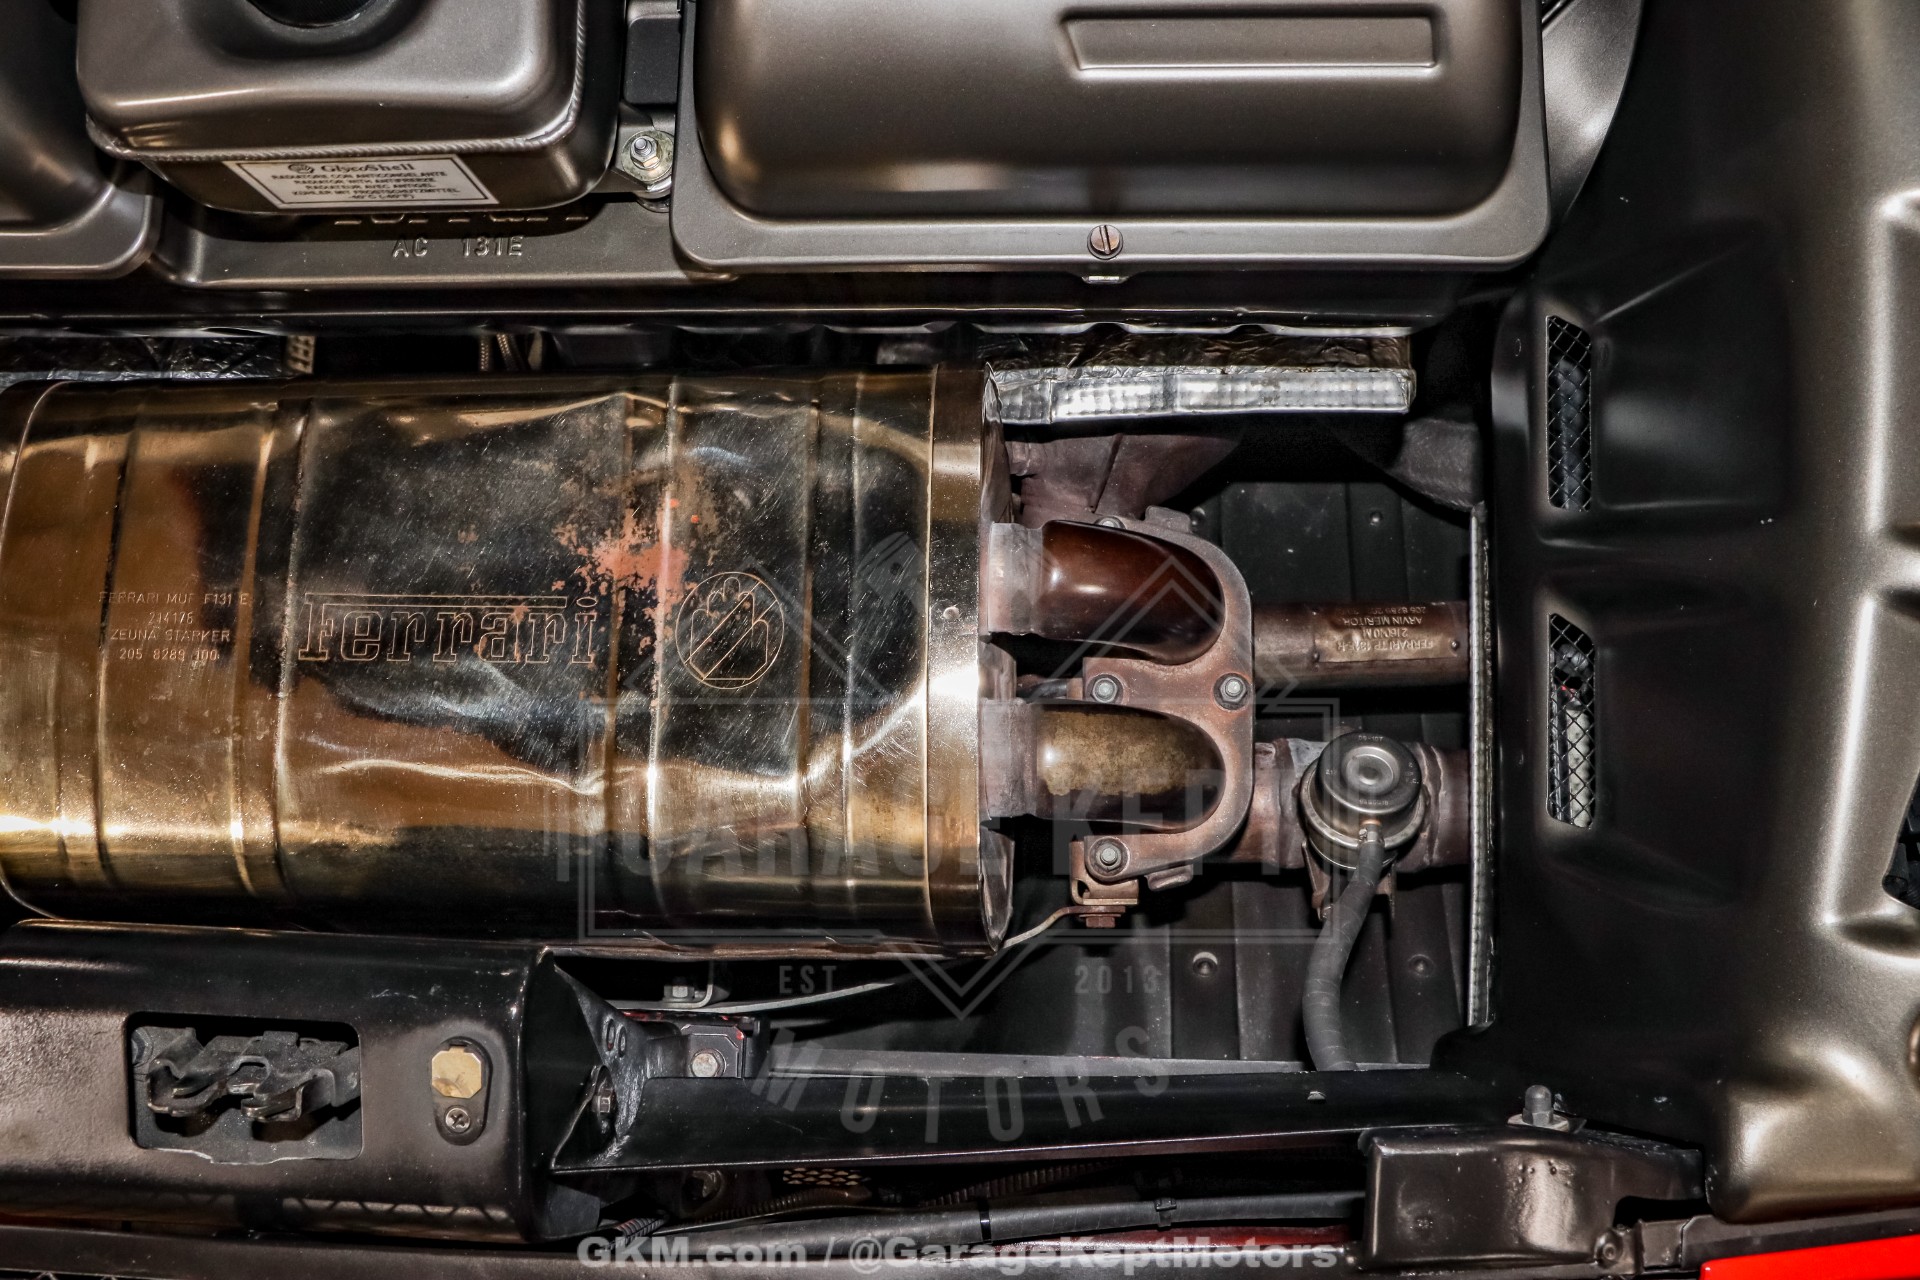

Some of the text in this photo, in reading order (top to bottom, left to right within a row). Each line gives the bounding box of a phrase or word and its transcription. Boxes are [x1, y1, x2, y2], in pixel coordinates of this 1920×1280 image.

[321, 163, 415, 174] GlycoShell
[392, 236, 524, 258] AC 131E
[1341, 616, 1423, 626] ARVIN MERITOR
[298, 593, 598, 665] Ferrari
[119, 648, 143, 660] 205
